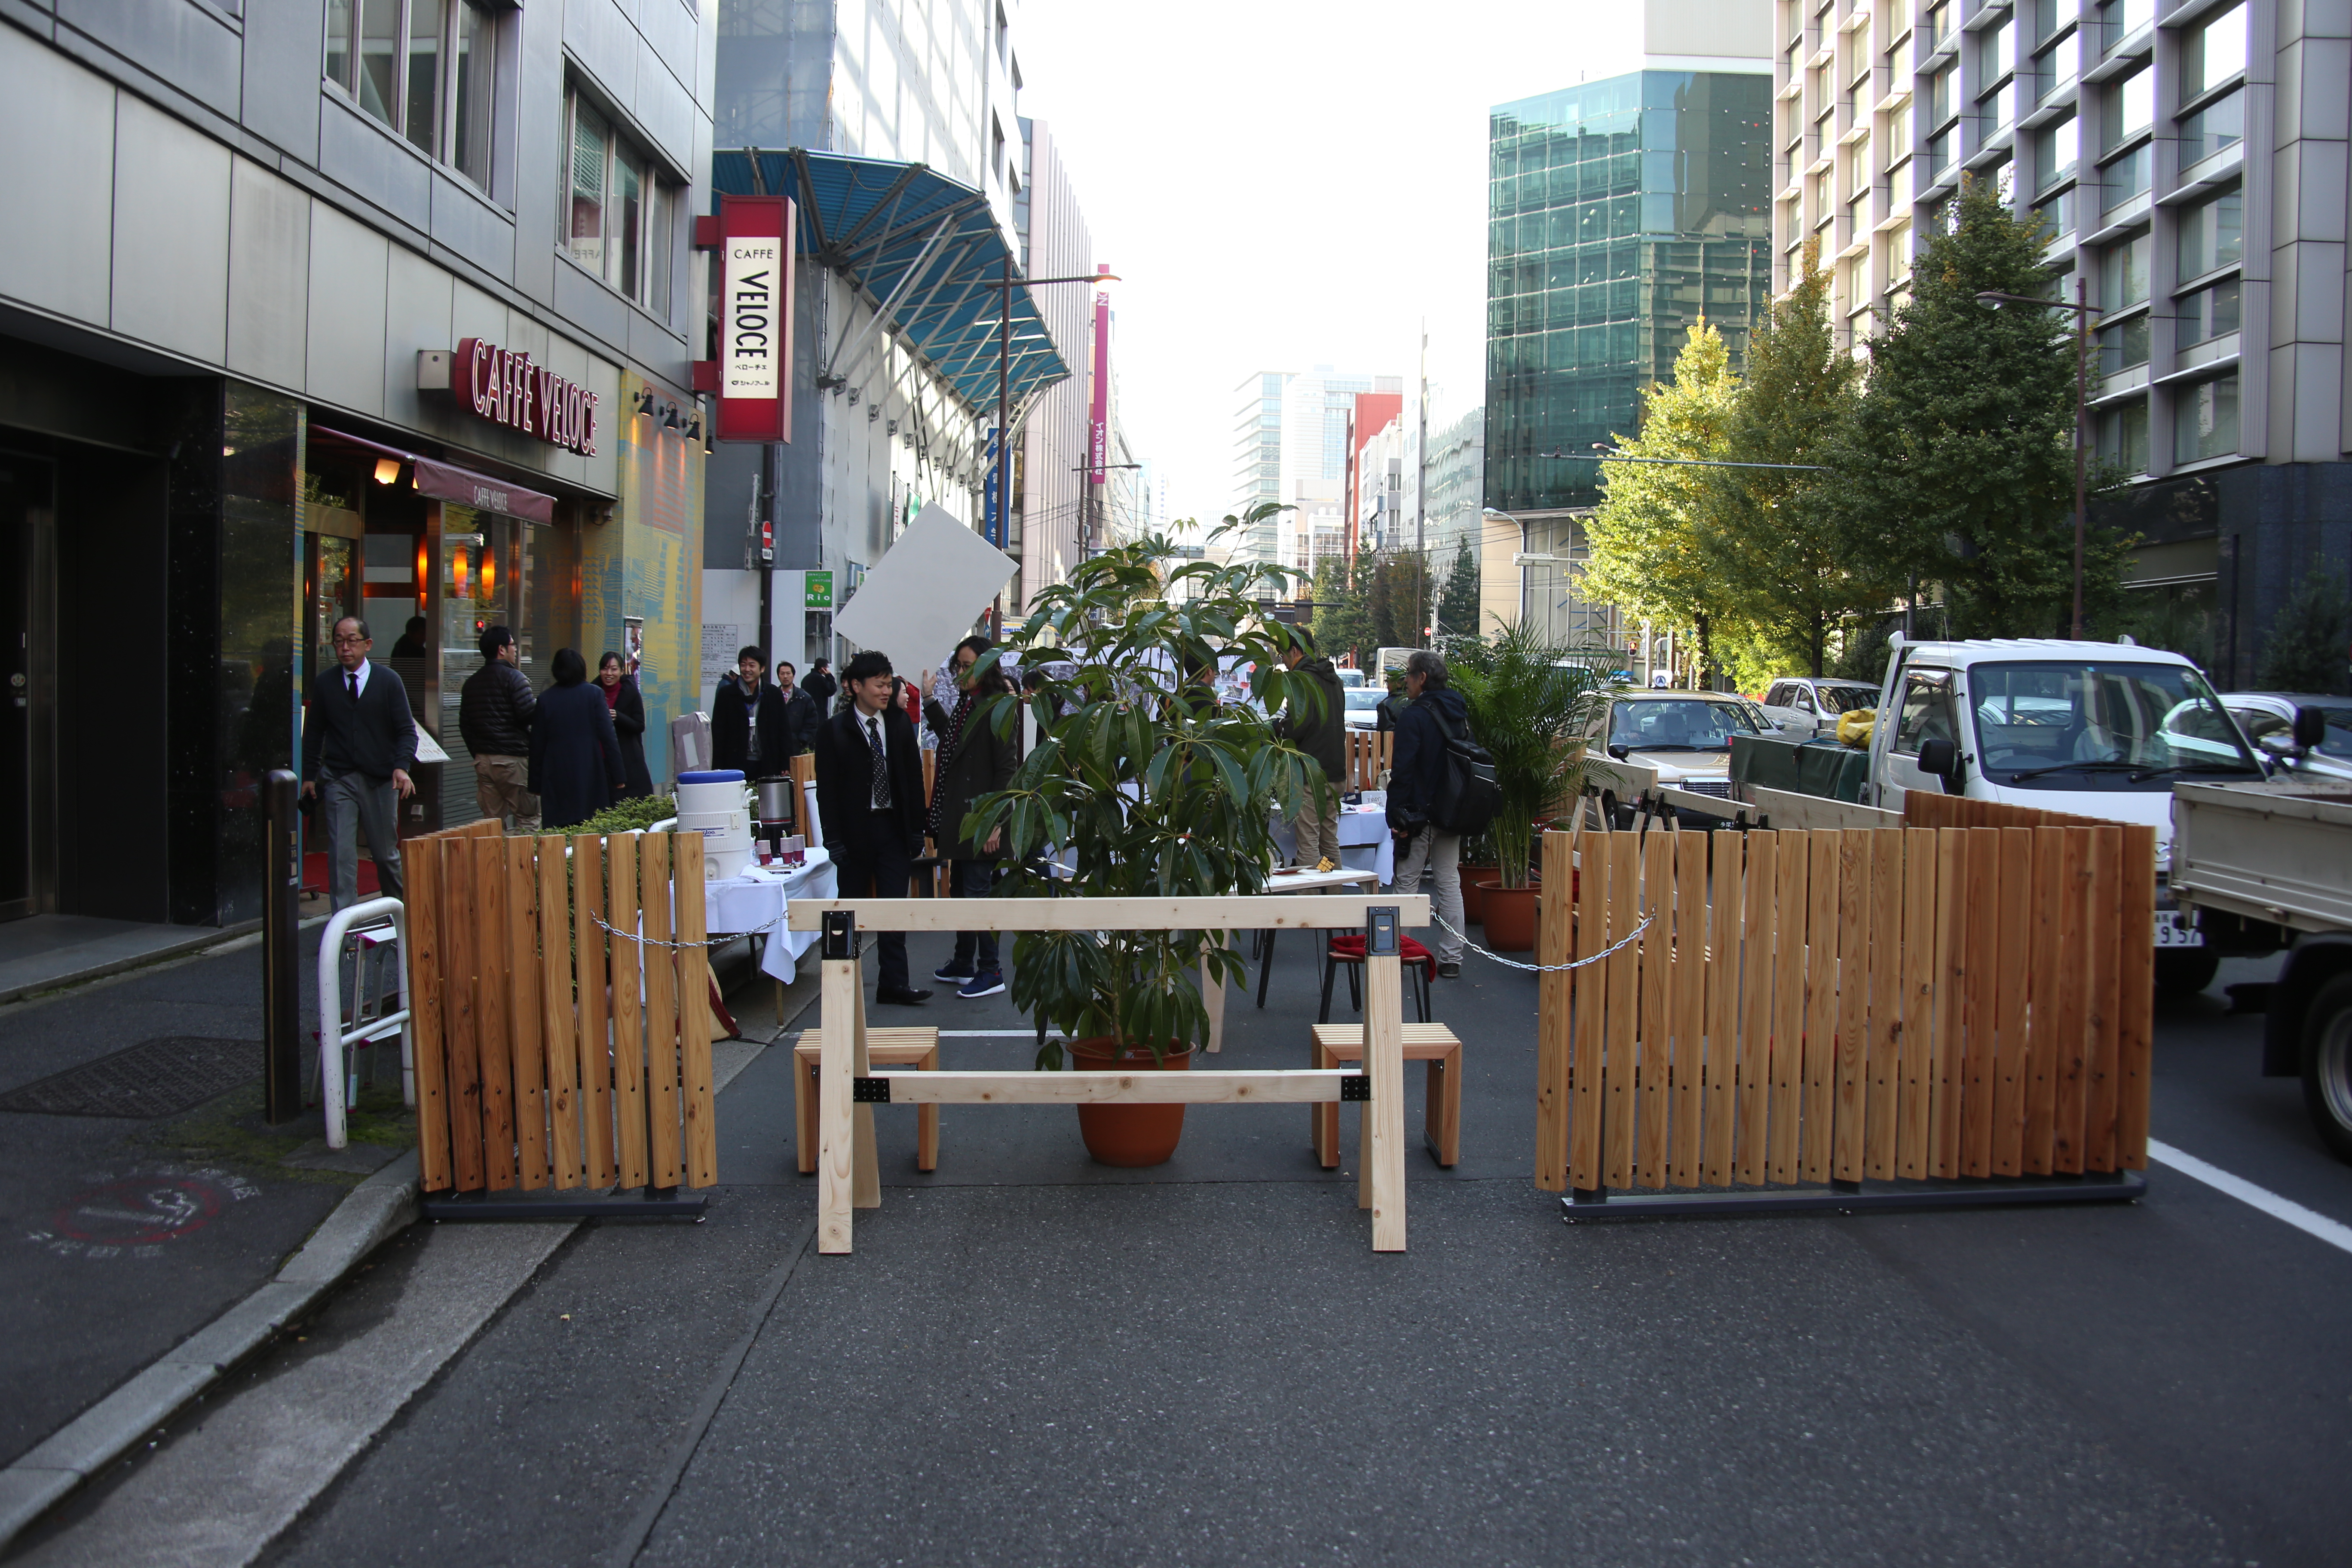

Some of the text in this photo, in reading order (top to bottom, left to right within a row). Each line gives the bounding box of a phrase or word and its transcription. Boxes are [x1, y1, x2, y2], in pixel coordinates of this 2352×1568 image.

[735, 248, 774, 260] CAFFÈ
[735, 270, 769, 358] VELOCE
[538, 366, 600, 458] VELOCE
[1094, 422, 1104, 475] イオン株式会社
[490, 489, 508, 512] VELOCE
